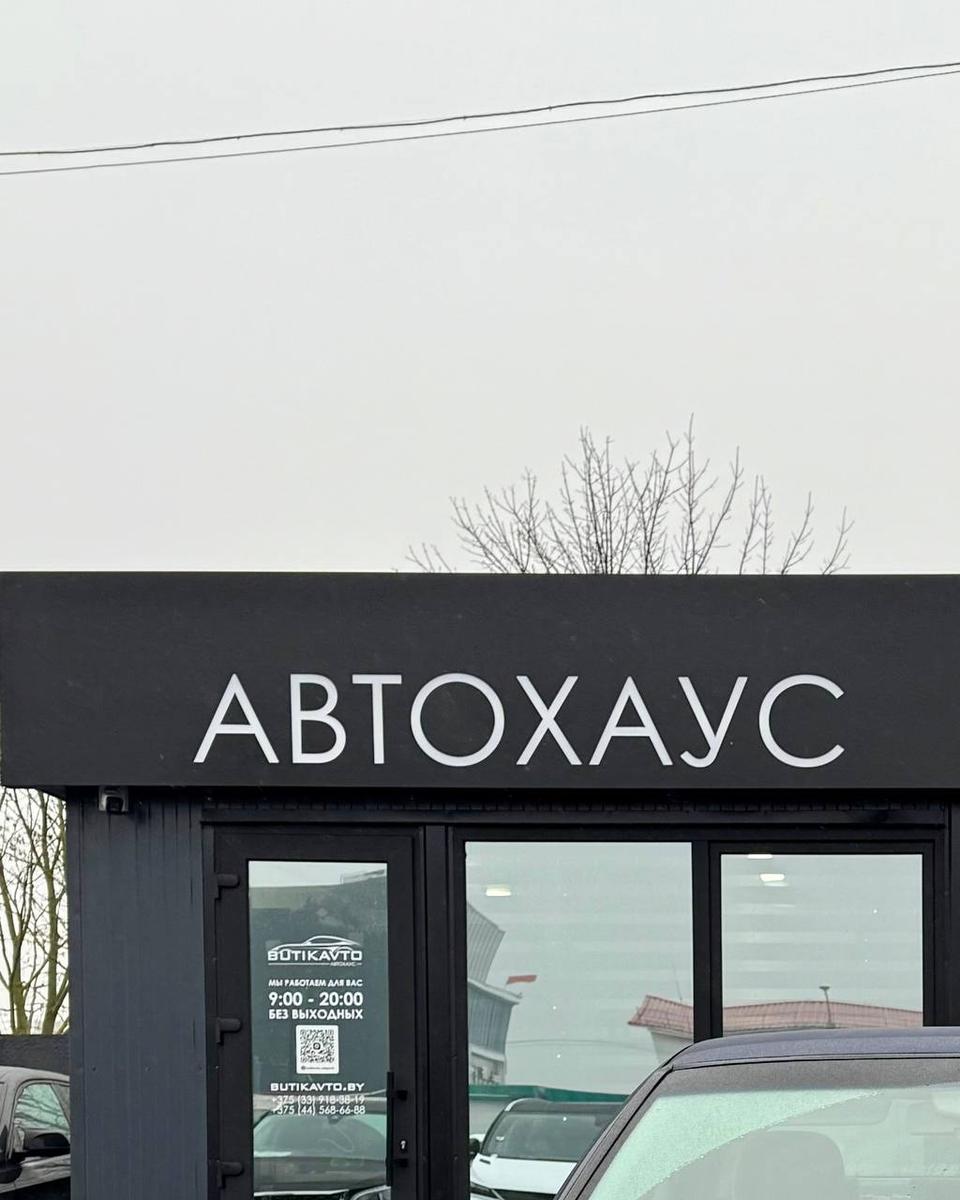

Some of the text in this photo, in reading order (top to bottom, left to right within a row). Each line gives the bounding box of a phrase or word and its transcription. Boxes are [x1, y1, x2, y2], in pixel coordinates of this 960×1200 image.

[193, 672, 845, 768] АВТОХАУС
[267, 950, 363, 961] BUTIKAVTO
[269, 979, 363, 988] МЫ РАБОТАЕМ ДЛЯ ВАС
[269, 992, 303, 1006] 9:00
[319, 992, 363, 1006] 20:00
[269, 1009, 363, 1021] БЕЗ ВЫХОДНЫХ
[270, 1083, 365, 1092] BUTIKAVTO.BY
[298, 1095, 315, 1106] (33)
[298, 1105, 316, 1116] (44)
[318, 1105, 366, 1115] 568-66-88
